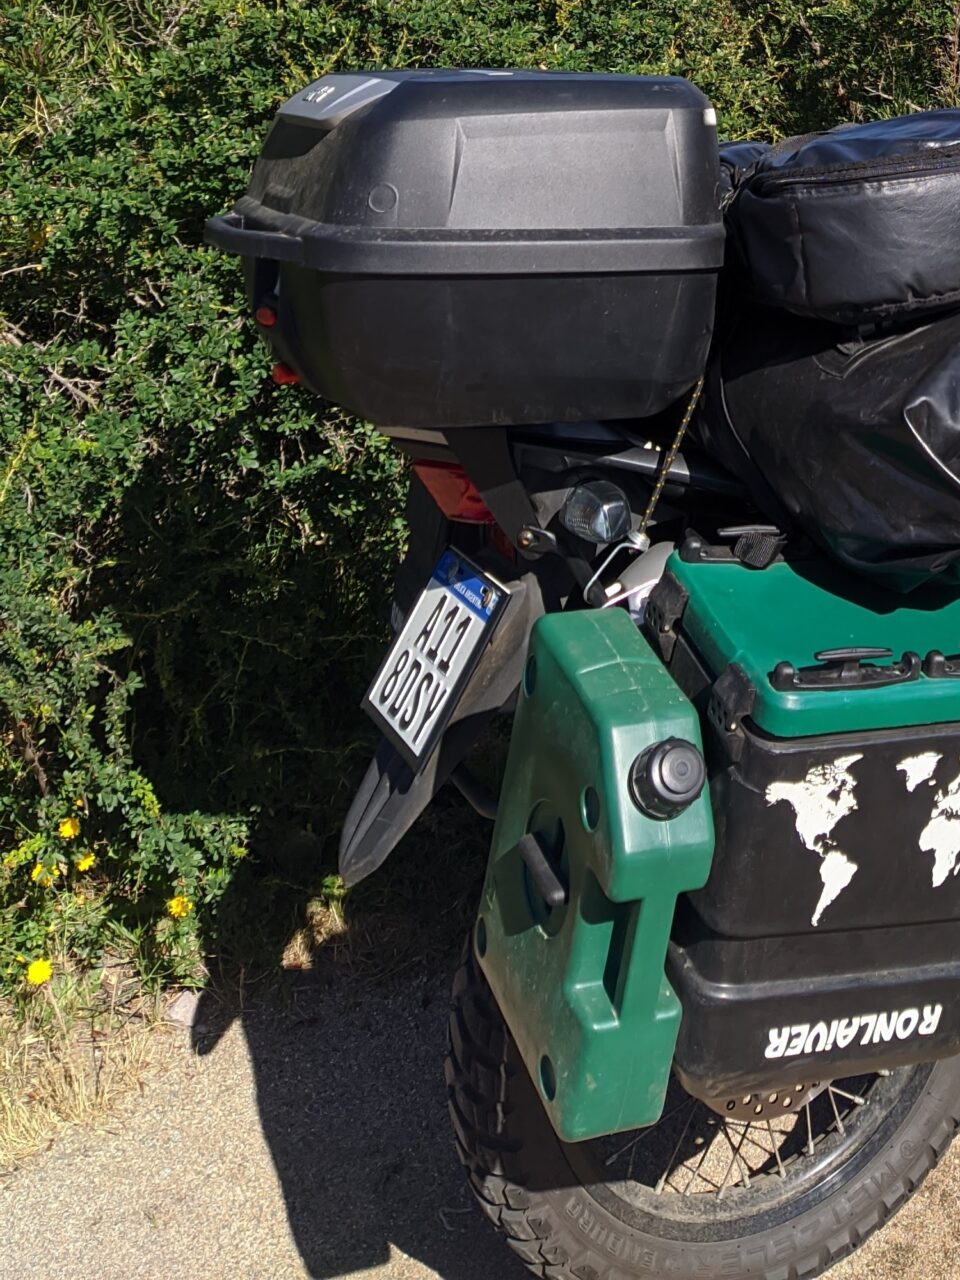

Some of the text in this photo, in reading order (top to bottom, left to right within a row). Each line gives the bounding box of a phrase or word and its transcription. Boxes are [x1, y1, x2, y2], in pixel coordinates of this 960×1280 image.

[413, 593, 473, 676] A11
[378, 649, 448, 745] 8DSY
[565, 1196, 656, 1271] ENDURO
